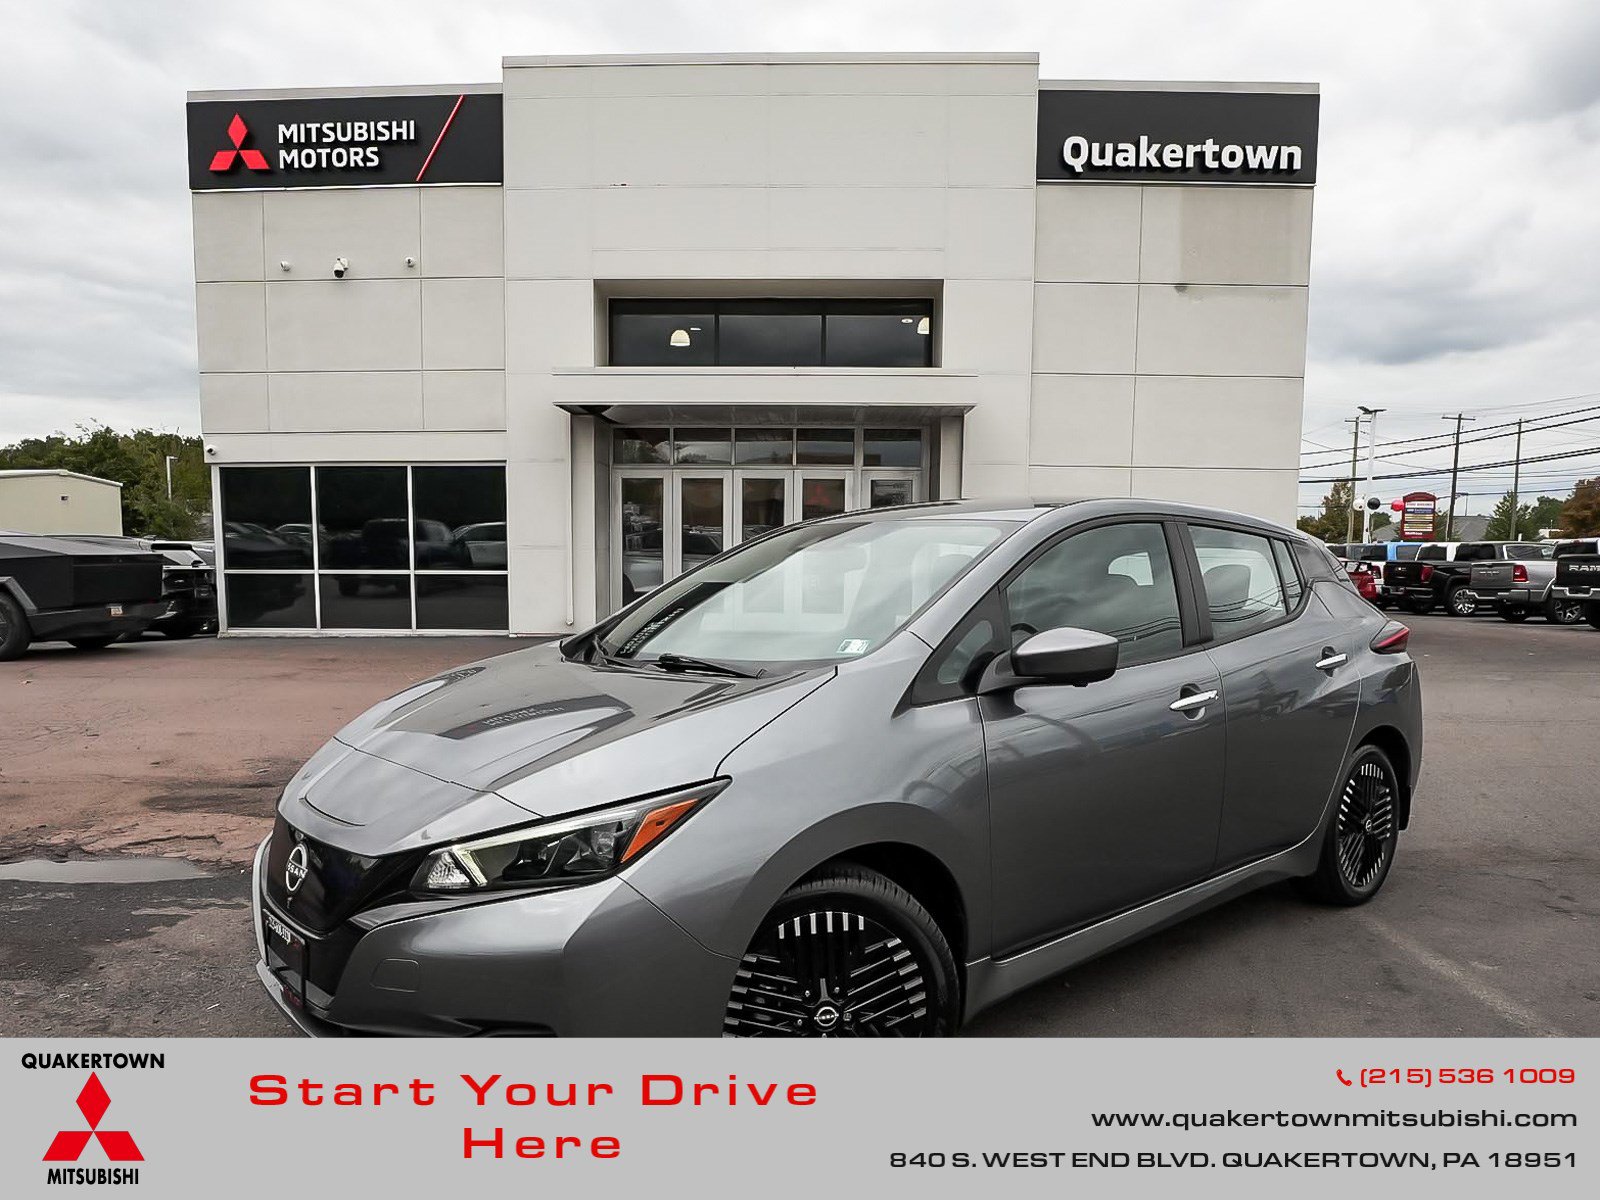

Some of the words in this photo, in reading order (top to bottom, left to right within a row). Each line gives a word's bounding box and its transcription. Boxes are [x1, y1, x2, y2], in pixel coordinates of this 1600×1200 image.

[278, 119, 415, 144] MITSUBISHI
[279, 146, 380, 170] MOTORS
[1063, 135, 1303, 173] Quakertown
